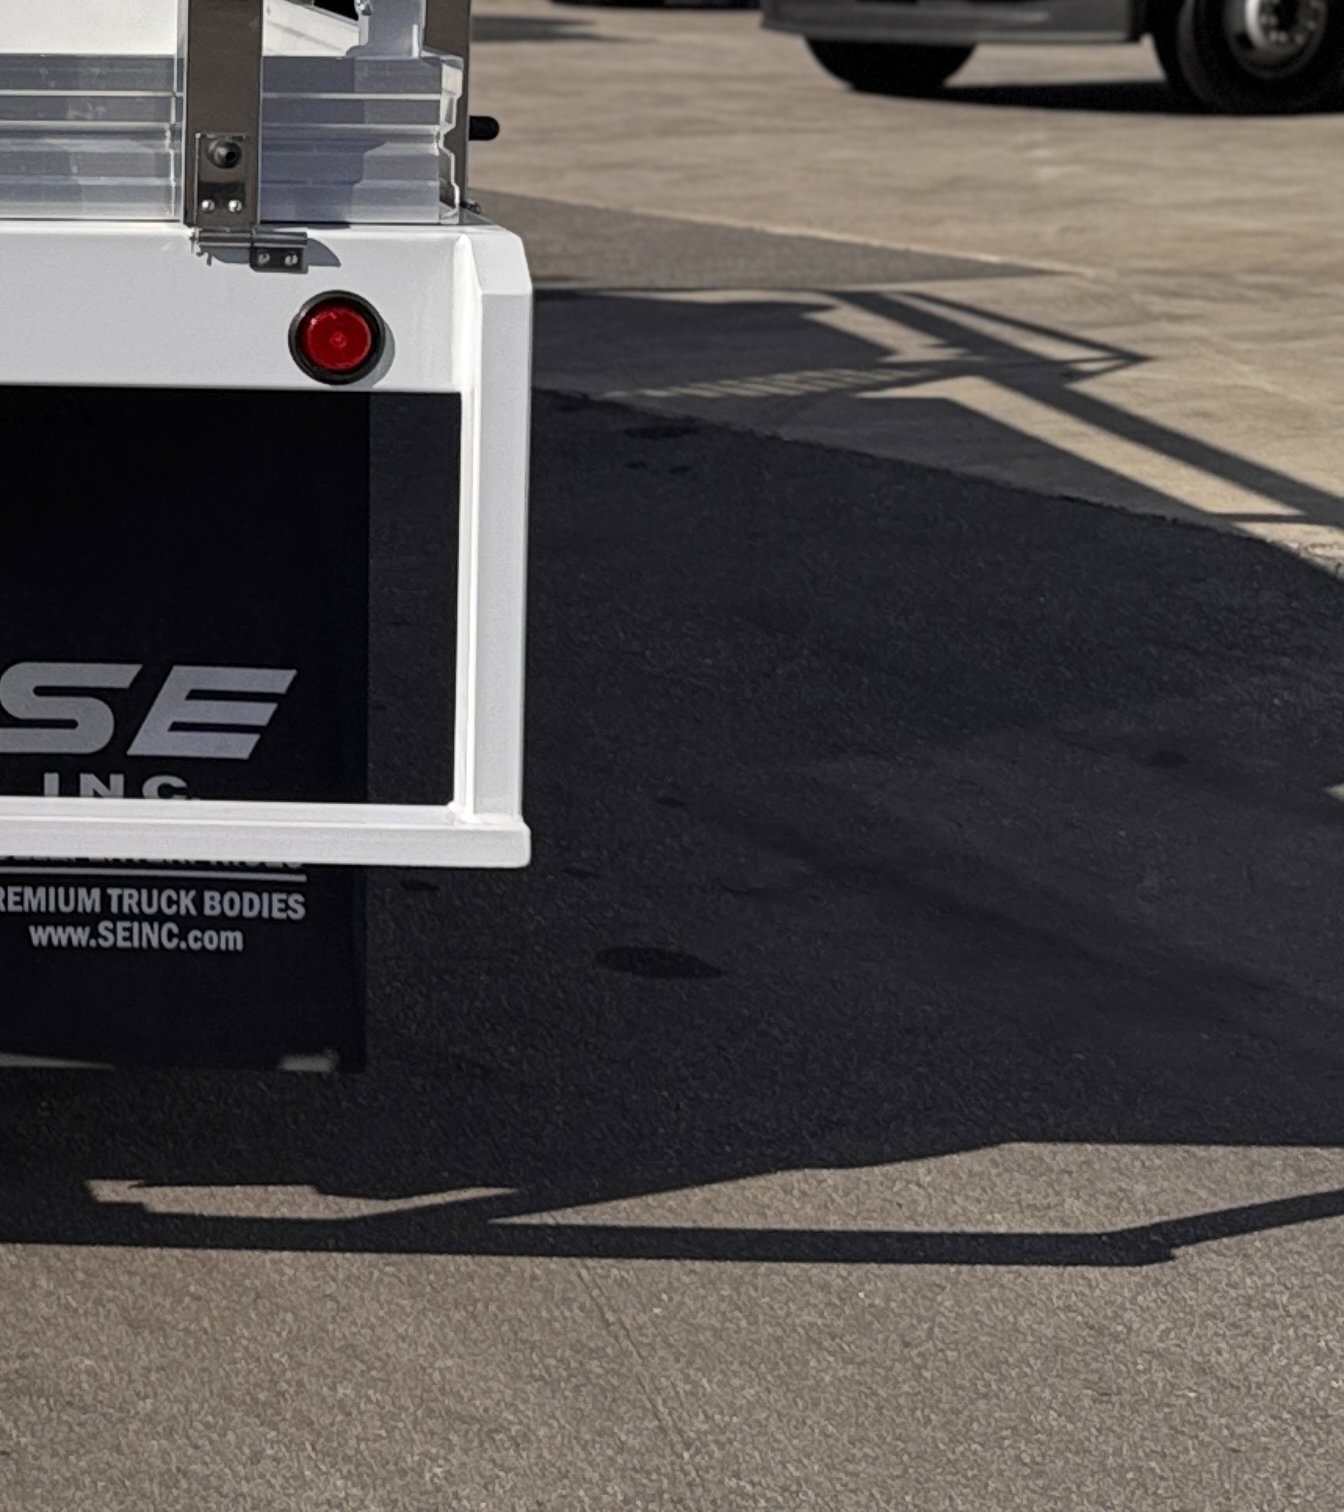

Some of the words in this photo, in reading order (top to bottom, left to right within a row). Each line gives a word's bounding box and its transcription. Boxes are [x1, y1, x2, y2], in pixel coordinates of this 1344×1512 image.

[106, 887, 197, 917] TRUCK
[204, 890, 307, 920] BODIES
[29, 920, 243, 952] www.SEINC.com
